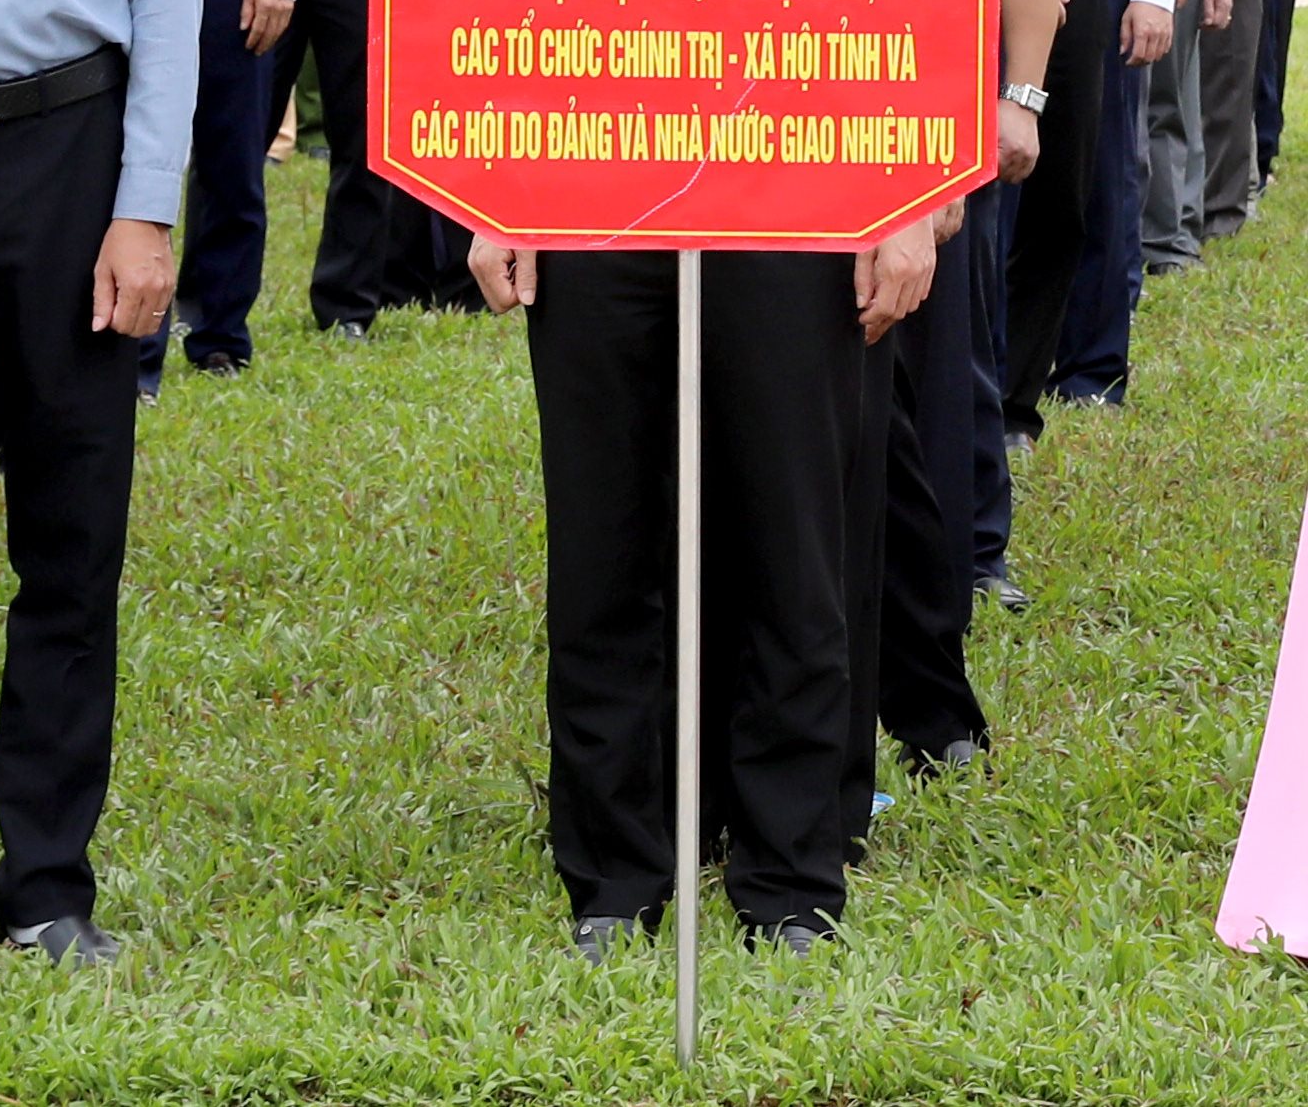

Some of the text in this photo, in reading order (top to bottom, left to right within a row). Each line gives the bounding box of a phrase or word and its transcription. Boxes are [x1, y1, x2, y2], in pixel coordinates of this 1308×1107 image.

[451, 18, 499, 76] CÁC
[505, 9, 535, 77] TỔ
[539, 19, 602, 78] CHỨC
[608, 20, 680, 79] CHÍNH
[686, 31, 723, 91] TRỊ
[743, 23, 776, 80] XÃ
[782, 22, 821, 92] HỘI
[827, 16, 881, 81] TỈNH
[886, 24, 917, 82] VÀ
[411, 96, 955, 176] CÁC HỘI DO ĐẢNG VÀ NHÀ NƯỚC GIAO NHIỆM VỤ
